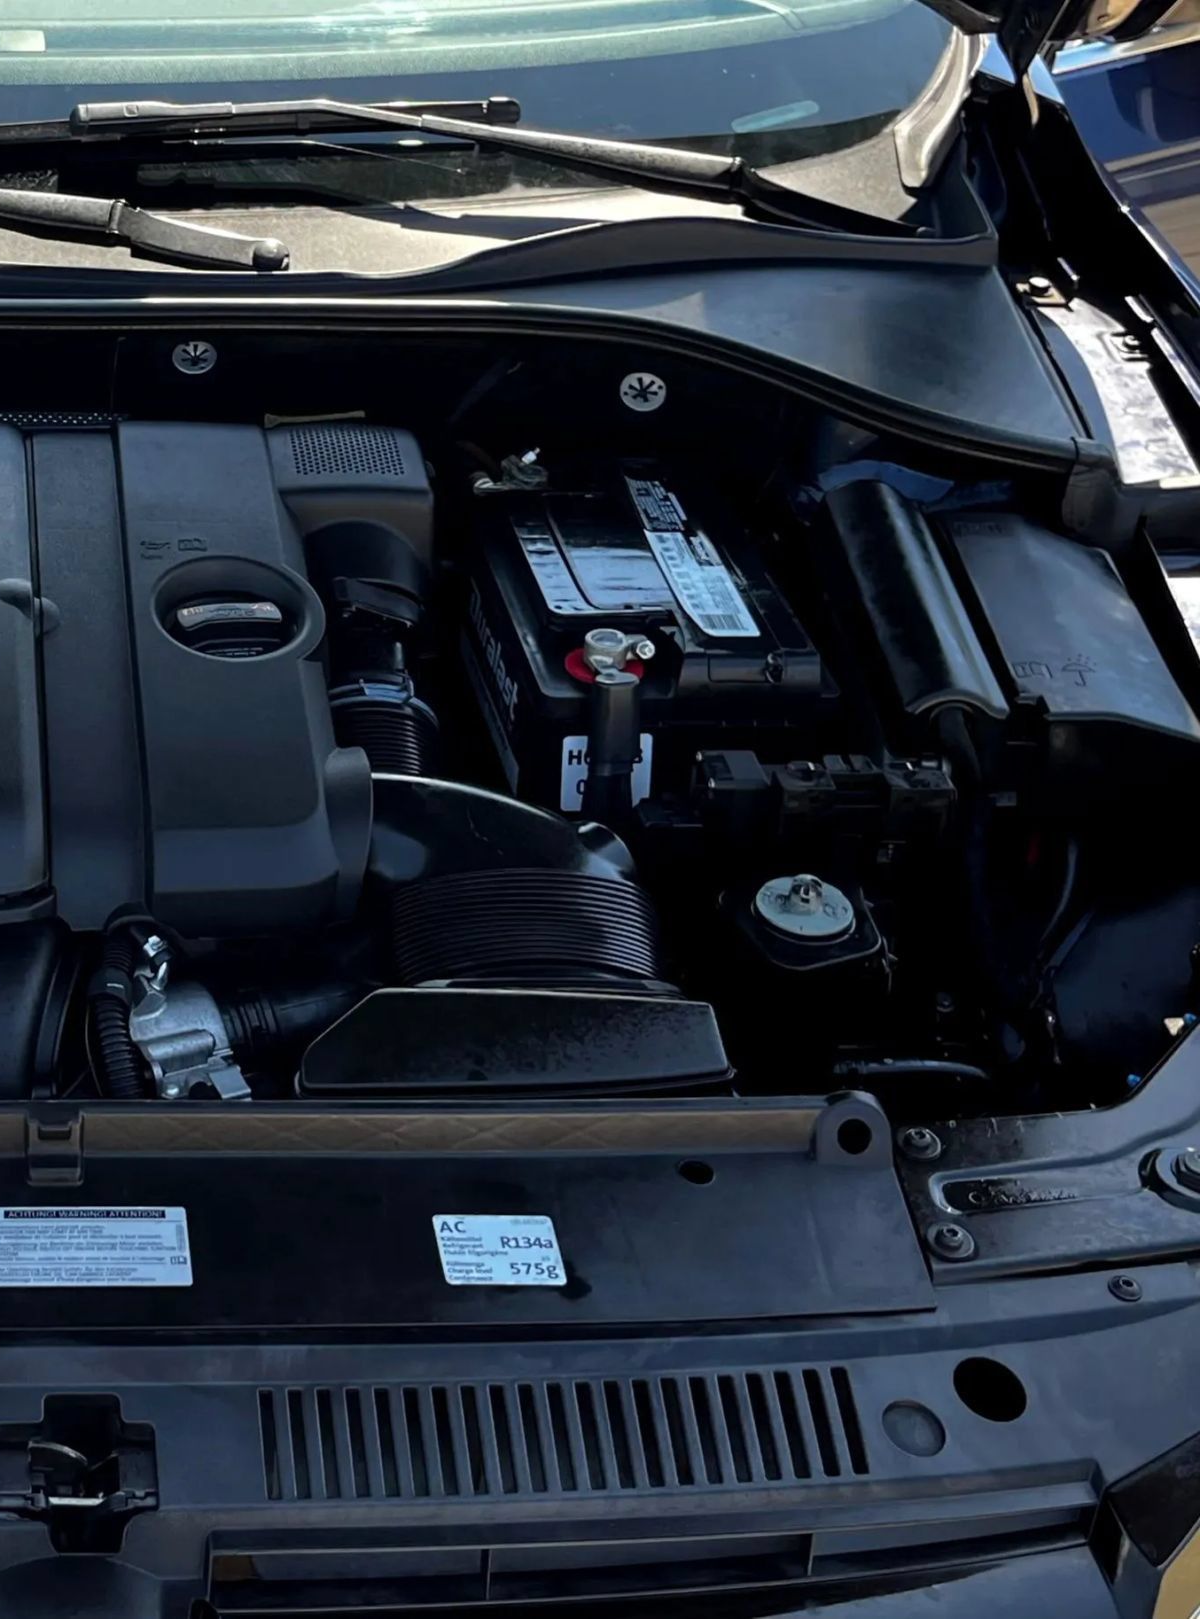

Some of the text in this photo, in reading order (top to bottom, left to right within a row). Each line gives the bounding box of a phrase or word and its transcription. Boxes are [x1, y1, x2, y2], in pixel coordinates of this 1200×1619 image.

[440, 1221, 466, 1233] AC
[500, 1236, 554, 1249] R134a
[510, 1262, 559, 1279] 575g
